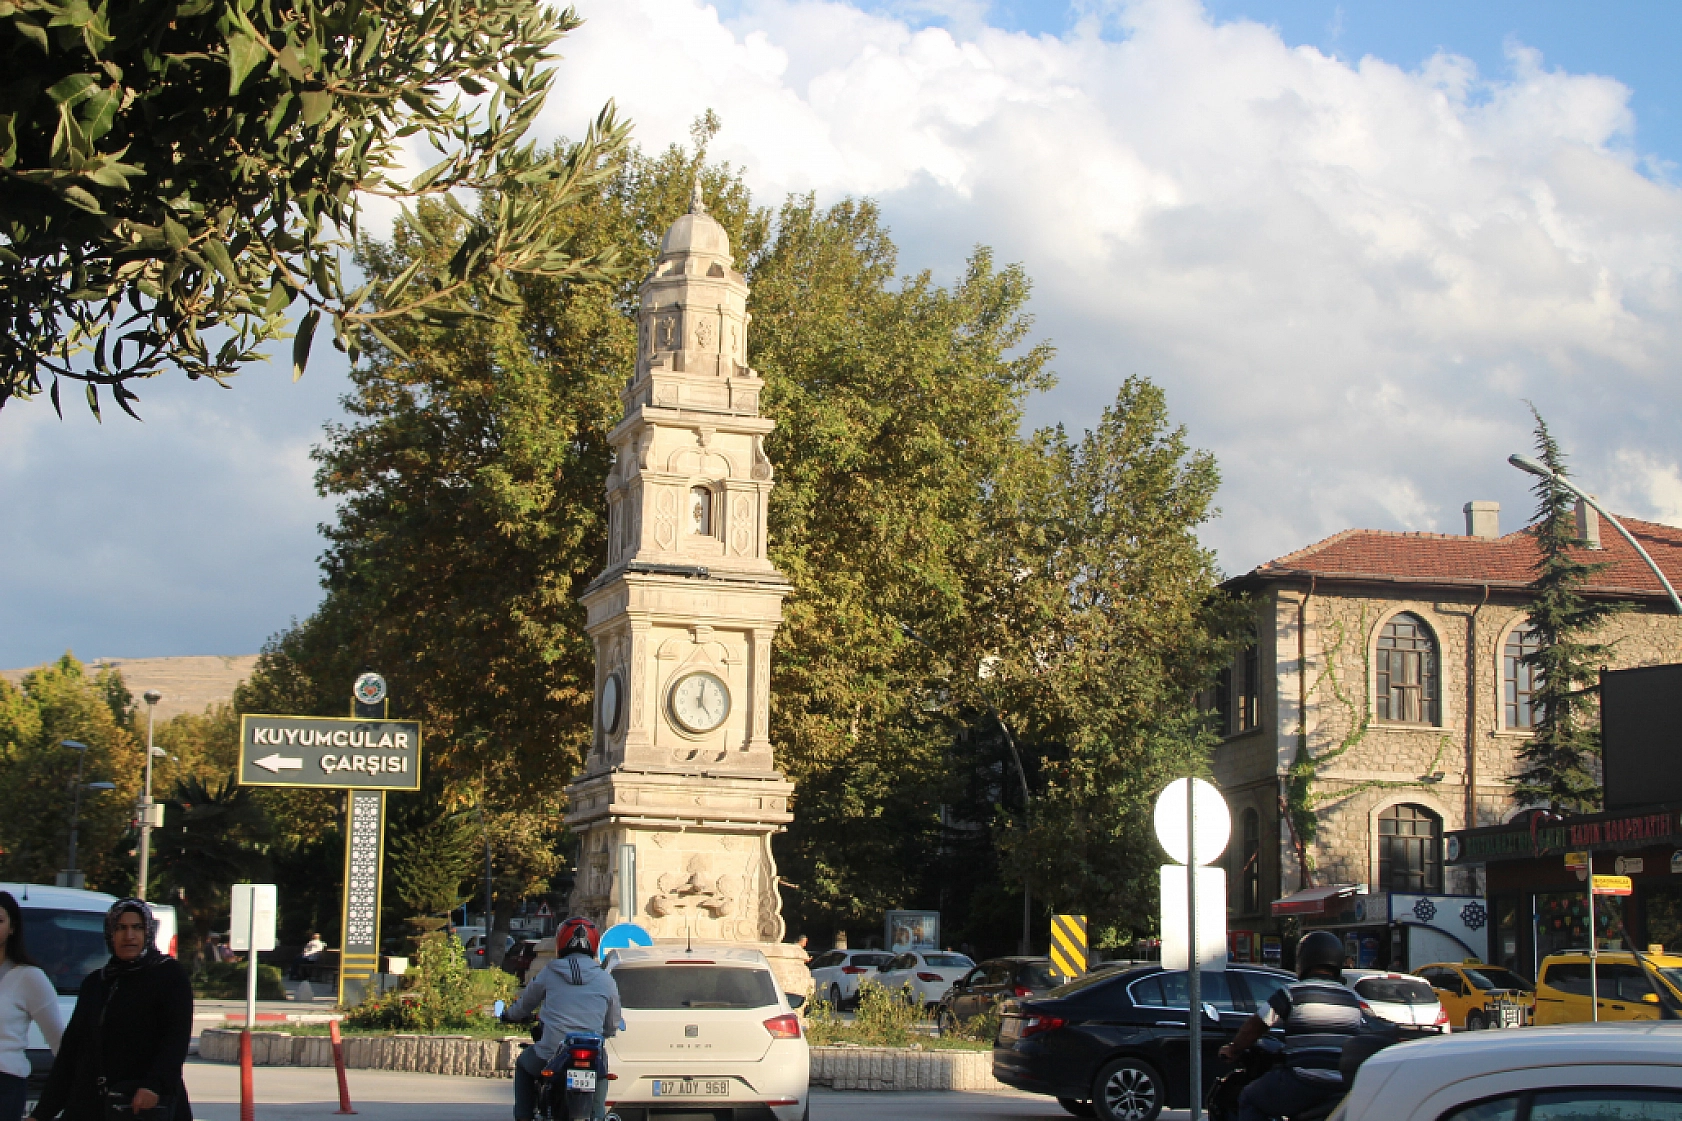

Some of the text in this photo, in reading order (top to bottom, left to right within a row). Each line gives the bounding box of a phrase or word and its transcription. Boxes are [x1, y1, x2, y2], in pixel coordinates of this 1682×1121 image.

[252, 727, 409, 749] KUYUMCULAR
[320, 754, 408, 776] ÇARŞISI
[661, 1081, 674, 1095] 07
